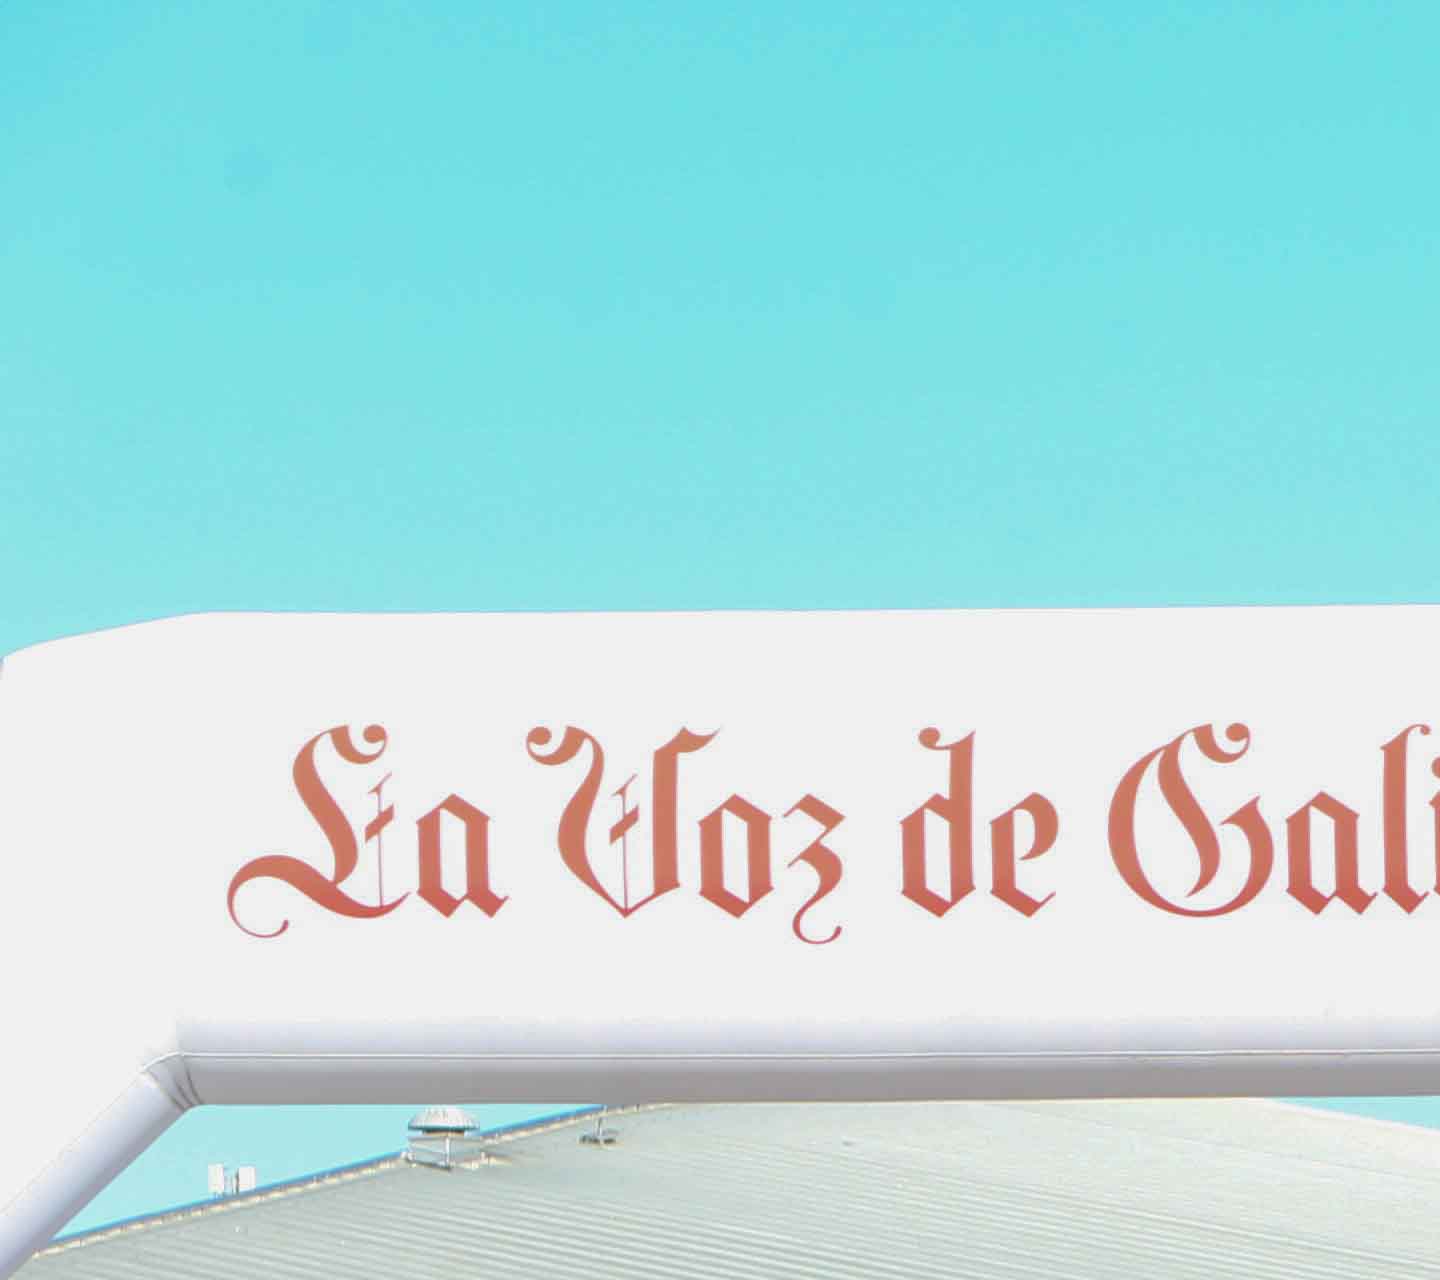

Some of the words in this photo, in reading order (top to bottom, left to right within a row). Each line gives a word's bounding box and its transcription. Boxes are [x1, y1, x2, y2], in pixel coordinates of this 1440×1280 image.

[227, 722, 511, 938] La
[525, 722, 845, 945] Voz
[899, 727, 1063, 916] de
